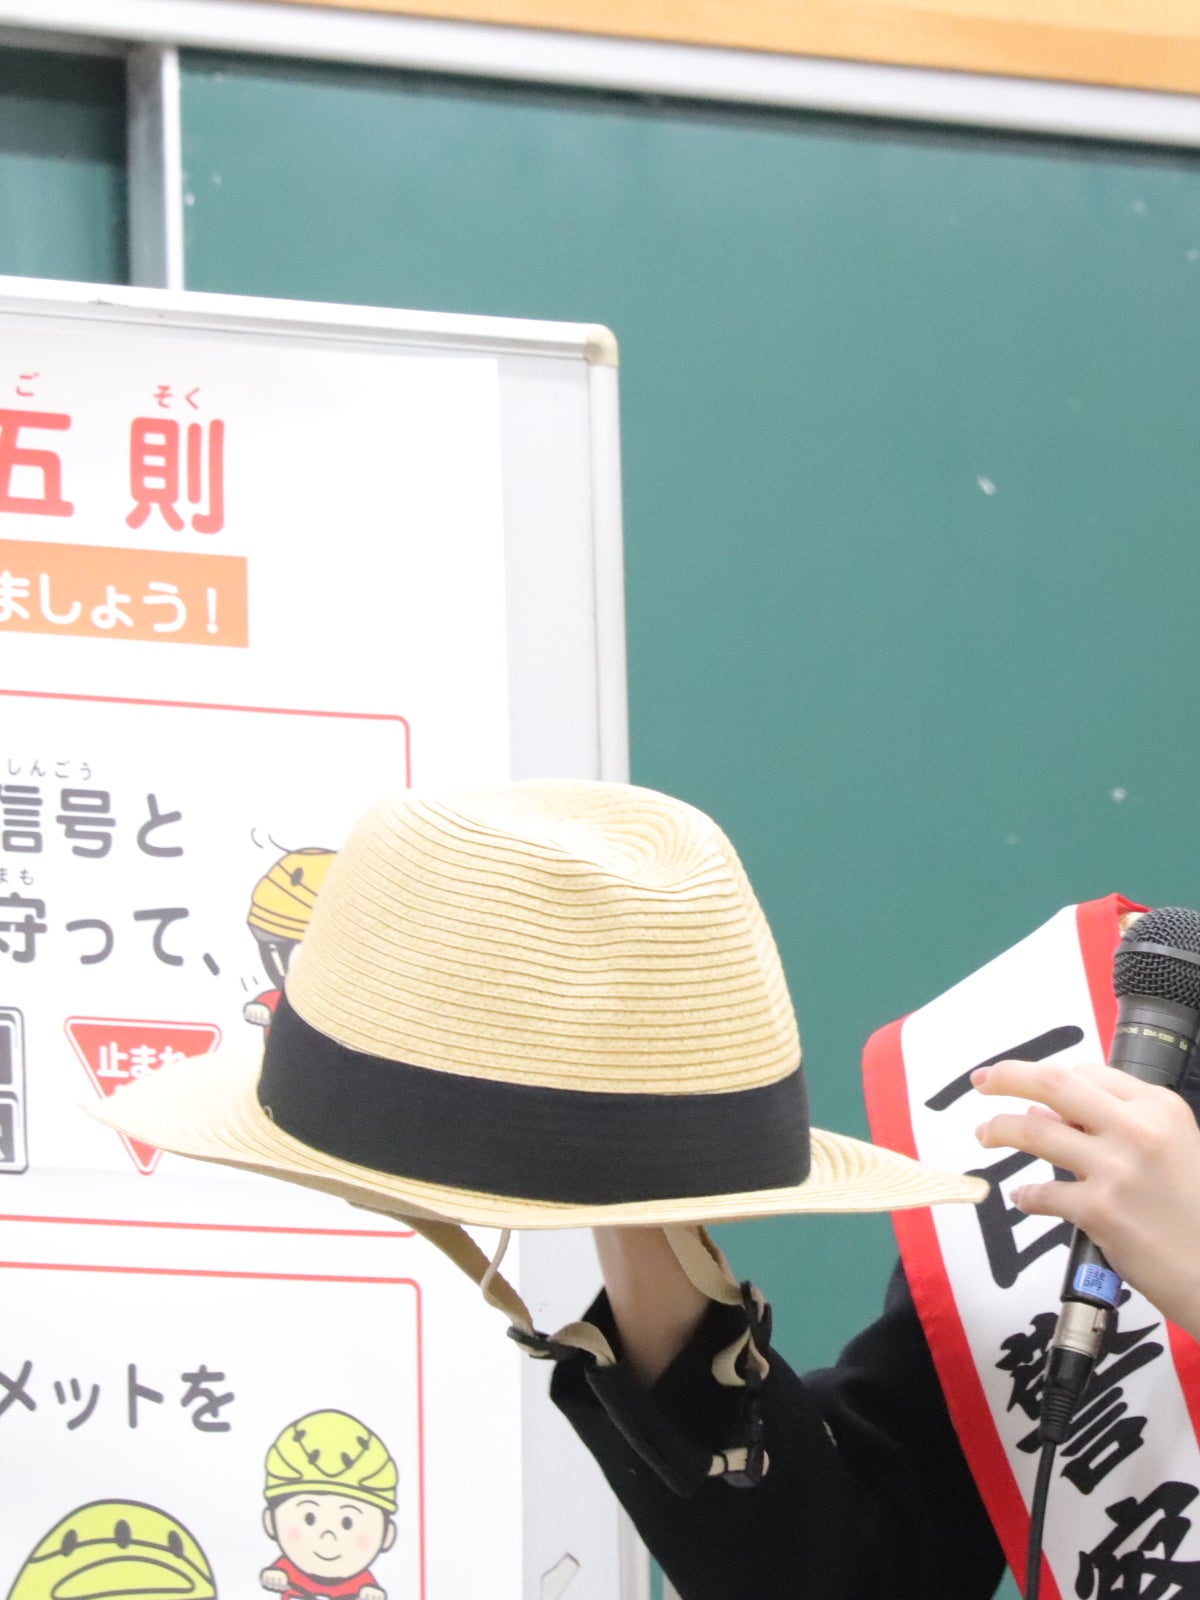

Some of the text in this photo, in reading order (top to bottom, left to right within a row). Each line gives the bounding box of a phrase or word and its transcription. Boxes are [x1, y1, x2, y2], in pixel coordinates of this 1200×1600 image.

[15, 372, 201, 410] ご そく
[0, 408, 225, 535] 五則
[8, 757, 92, 781] しんごう
[0, 784, 185, 859] 信号と
[0, 1360, 235, 1433] メットを
